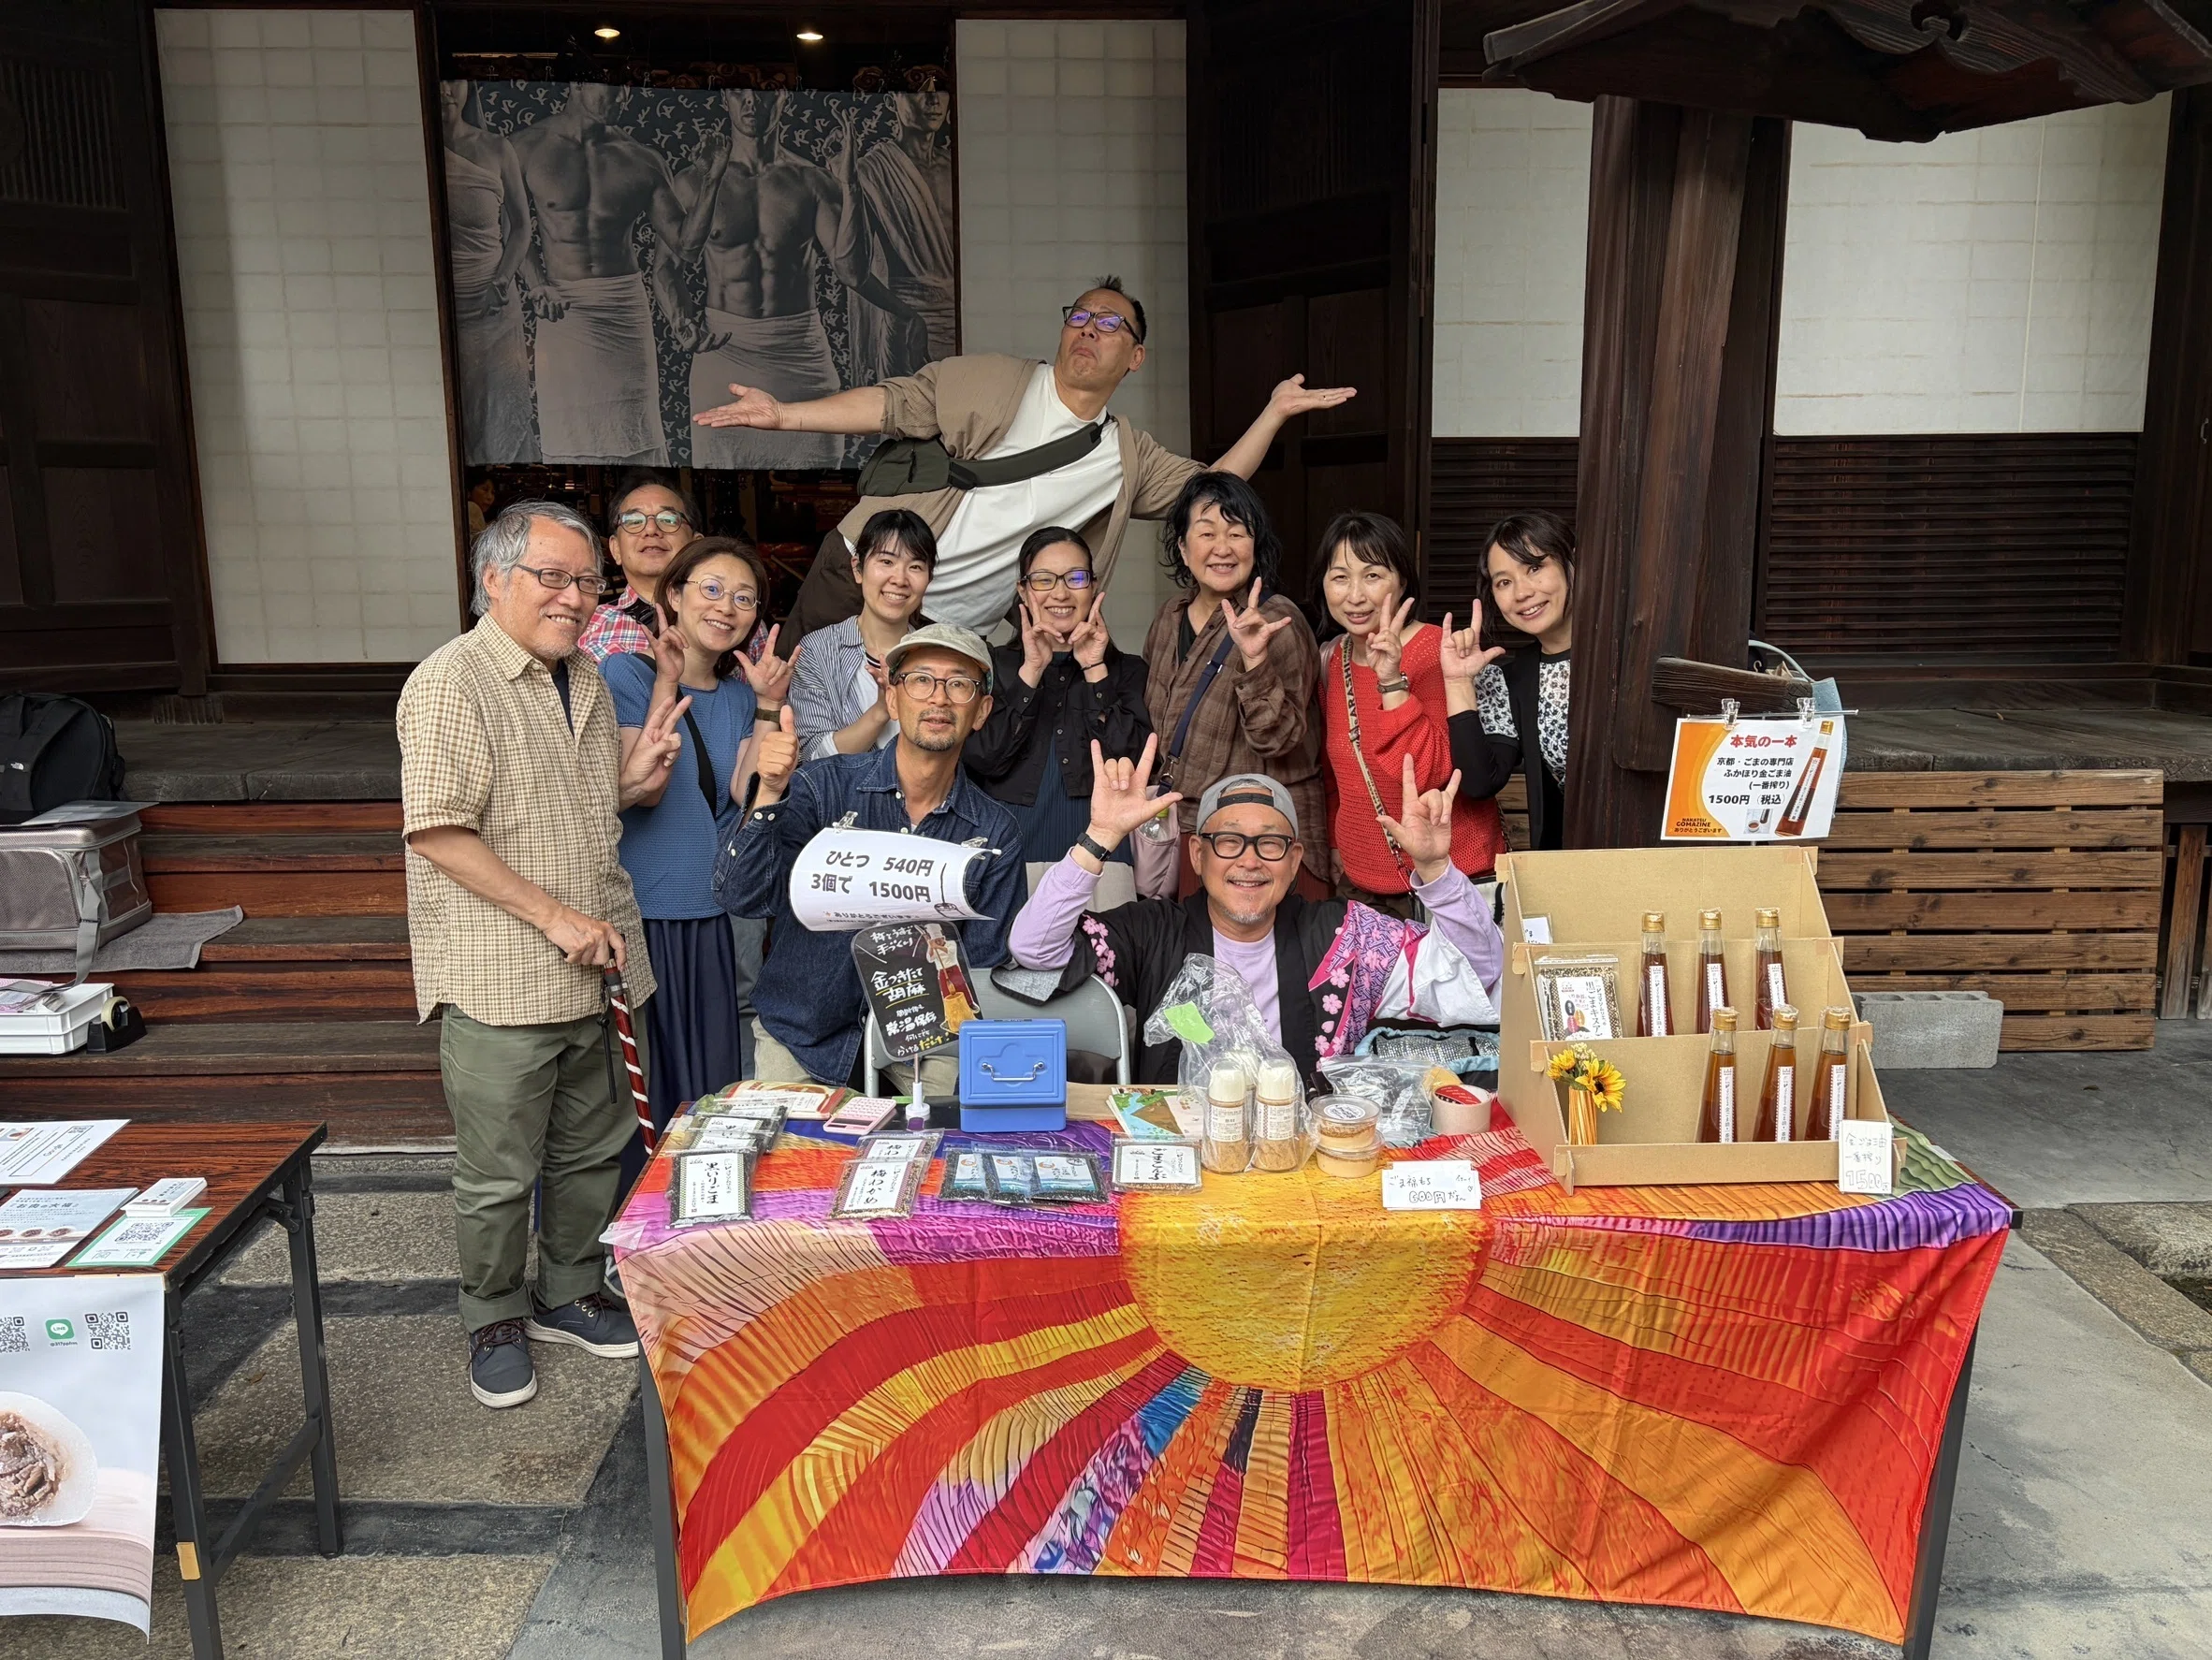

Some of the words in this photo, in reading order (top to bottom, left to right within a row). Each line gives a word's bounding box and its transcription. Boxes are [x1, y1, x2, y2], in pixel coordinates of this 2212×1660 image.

[1730, 735, 1797, 749] 本気の一本
[1716, 757, 1794, 766] 京都・ごまの専門店
[1724, 769, 1792, 778] ふかほり金ごま油
[825, 851, 870, 867] ひとつ
[882, 856, 935, 877] 540円
[810, 873, 853, 894] 3個で
[868, 881, 932, 903] 1500円
[877, 937, 913, 955] 手づくり
[882, 982, 926, 1002] 胡麻
[885, 1011, 937, 1037] 常温保存
[704, 1162, 720, 1204] 黒いりごま
[1845, 1169, 1890, 1191] 1500円
